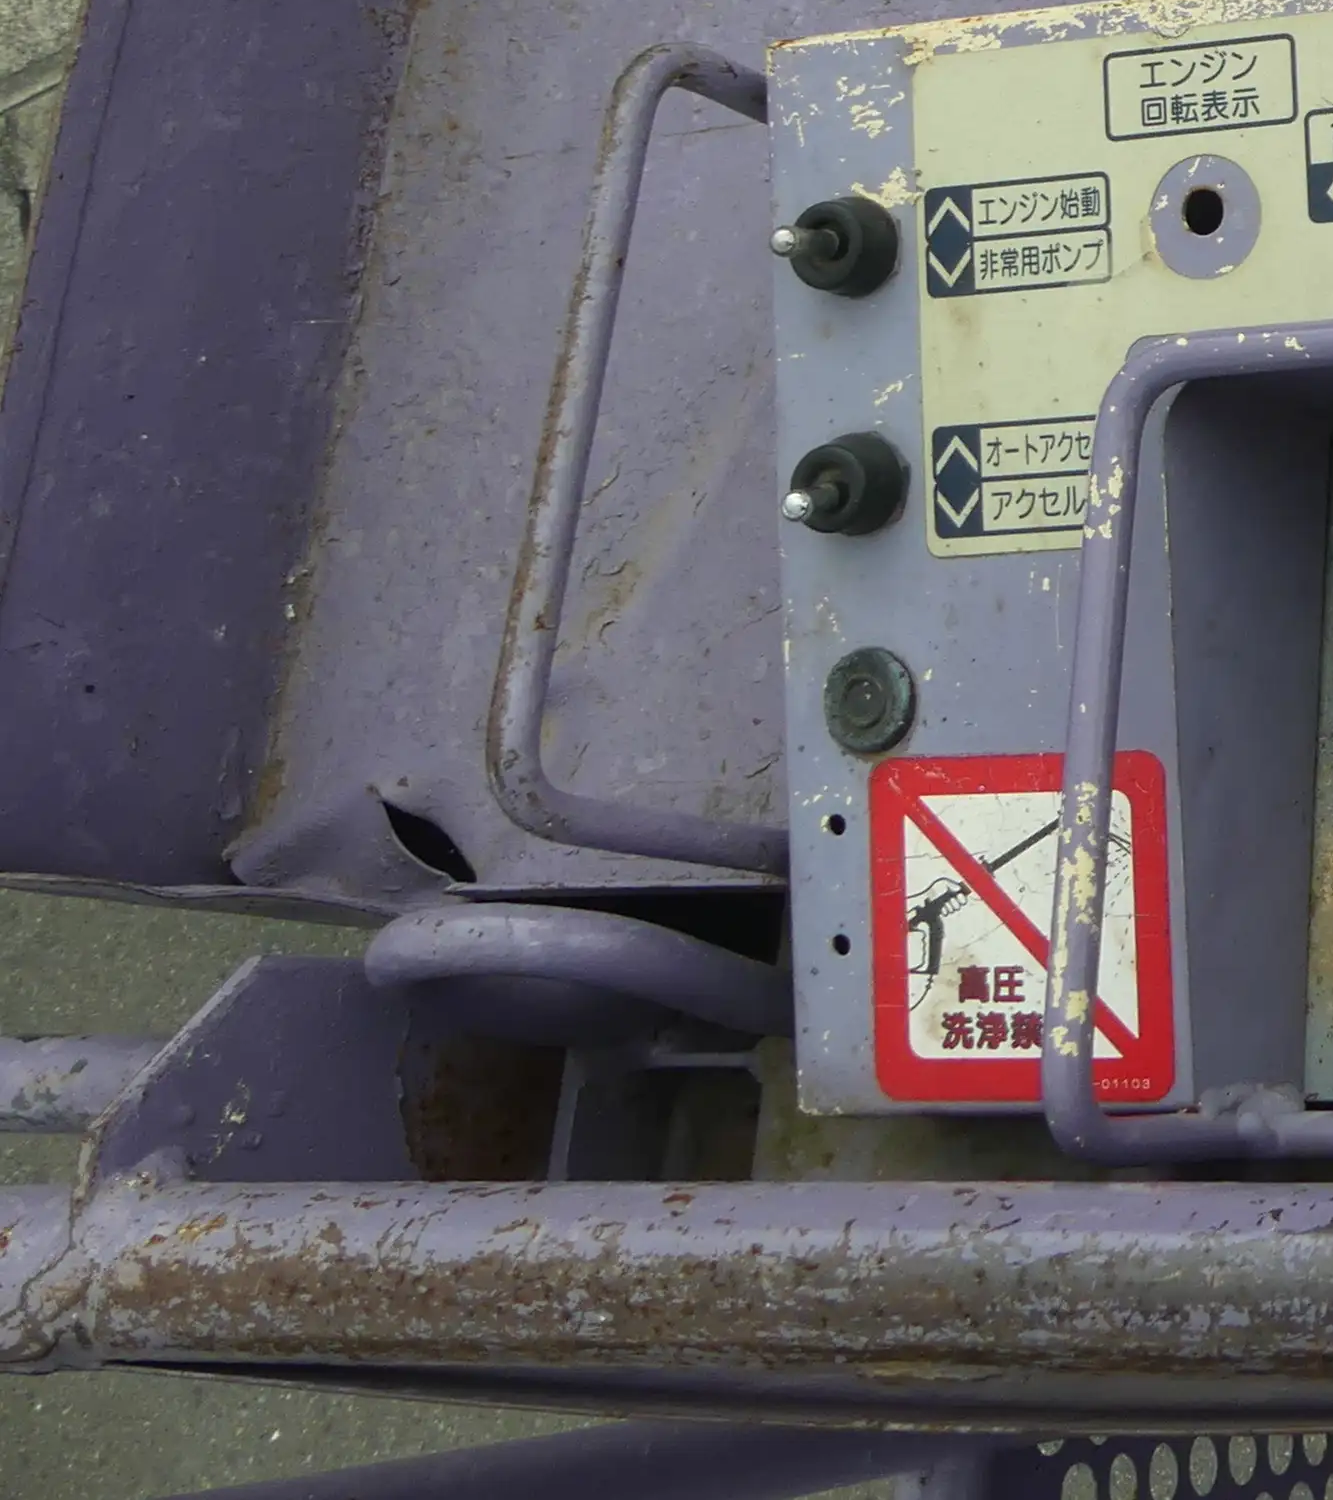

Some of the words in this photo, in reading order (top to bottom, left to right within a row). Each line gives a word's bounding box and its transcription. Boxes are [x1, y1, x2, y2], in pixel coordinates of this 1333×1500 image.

[1140, 50, 1257, 88] エンジン
[1142, 87, 1260, 126] 回転表示
[979, 187, 1100, 226] エンジン始動
[980, 239, 1104, 280] 非常用ポンプ
[987, 431, 1091, 467] オートアクセ
[991, 486, 1087, 520] アクセル
[957, 965, 1025, 1003] 高圧
[942, 1011, 1043, 1049] 洗浄禁
